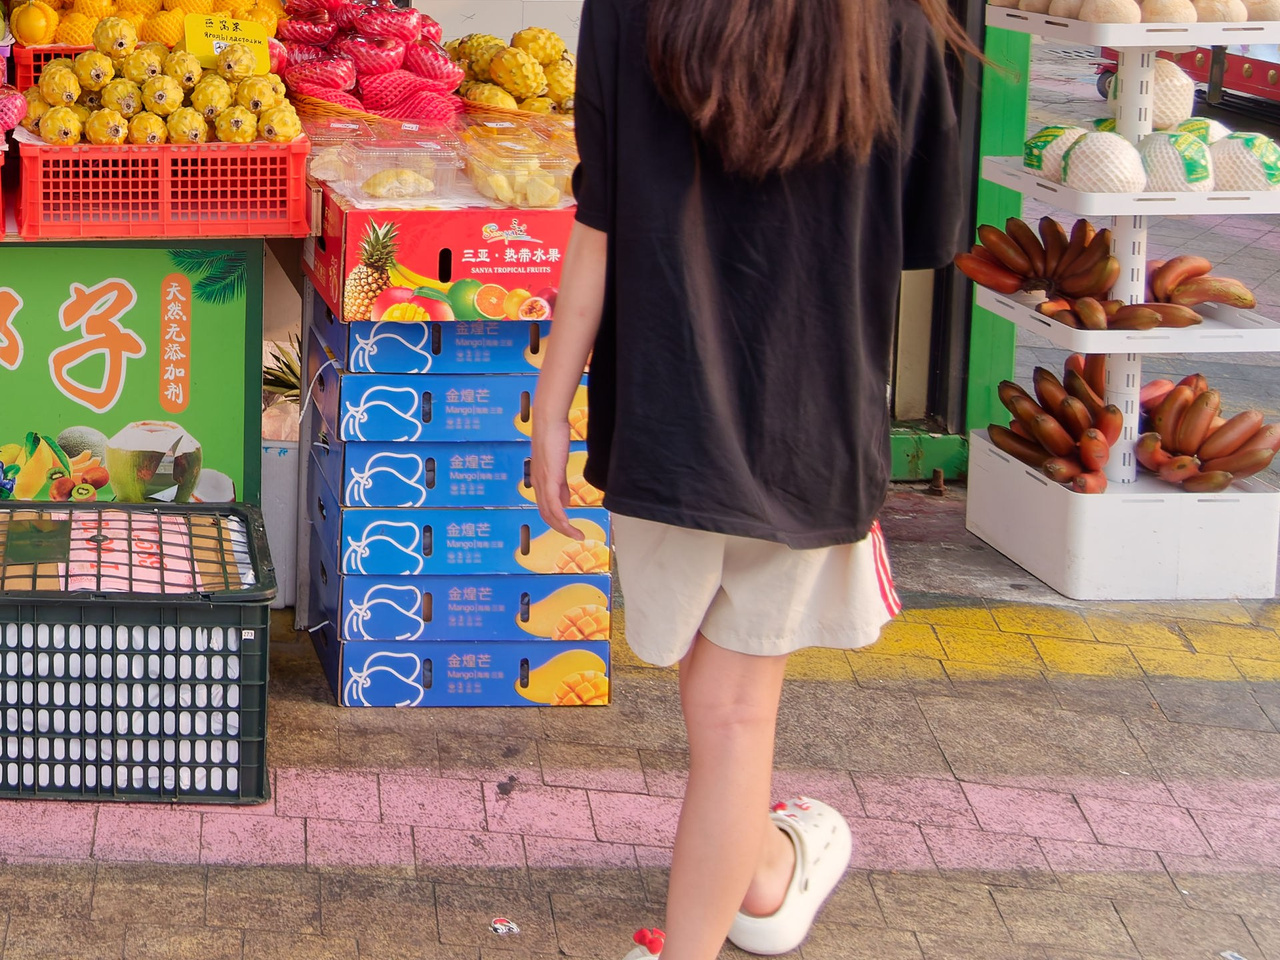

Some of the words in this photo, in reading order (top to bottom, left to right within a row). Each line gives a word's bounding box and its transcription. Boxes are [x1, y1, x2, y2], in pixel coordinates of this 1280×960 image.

[462, 248, 561, 263] 三亚·热带水果
[164, 282, 189, 404] 天然无添加剂
[445, 388, 490, 403] 金煌芒
[449, 454, 494, 469] 金煌芒
[446, 523, 491, 538] 金煌芒
[448, 587, 492, 602] 金煌芒
[447, 654, 491, 668] 金煌芒
